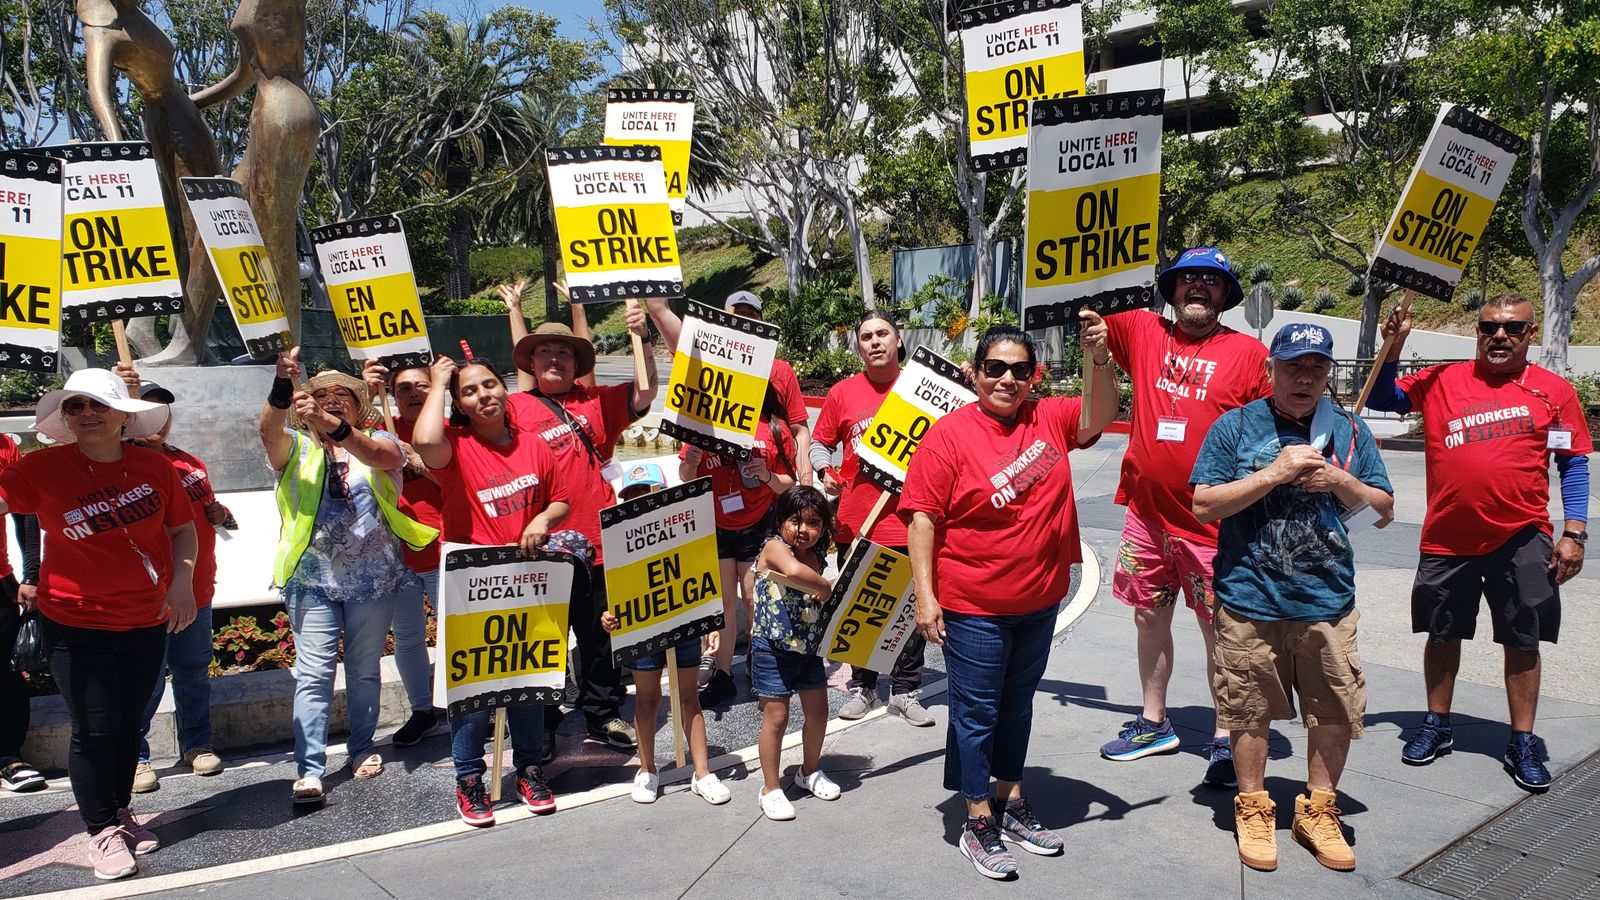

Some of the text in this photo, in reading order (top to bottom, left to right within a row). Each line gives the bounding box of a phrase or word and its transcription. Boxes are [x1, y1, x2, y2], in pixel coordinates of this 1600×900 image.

[985, 21, 1058, 45] UNITE HERE!
[986, 33, 1060, 58] LOCAL 11
[1005, 64, 1046, 99] ON
[621, 120, 676, 132] LOCAL 11
[622, 111, 677, 122] UNITE HERE!
[1059, 130, 1138, 155] UNITE HERE!
[1446, 140, 1497, 171] UNITE HERE!
[1058, 146, 1138, 174] LOCAL 11
[1439, 152, 1492, 185] LOCAL 11
[88, 173, 131, 185] HERE!
[573, 171, 644, 183] UNITE HERE!
[575, 182, 647, 195] LOCAL 11
[116, 185, 134, 198] 11
[12, 206, 31, 223] 11
[209, 209, 237, 221] UNITE
[1075, 187, 1119, 233] ON
[1430, 187, 1468, 226] ON
[70, 215, 124, 250] ON
[214, 221, 250, 236] LOCAL
[597, 208, 639, 236] ON
[569, 236, 674, 268] STRIKE
[1035, 223, 1151, 280] STRIKE
[1392, 210, 1474, 266] STRIKE
[239, 251, 268, 283] ON
[328, 245, 384, 262] UNITE HERE!
[330, 255, 387, 275] LOCAL 11
[346, 285, 376, 314] EN
[338, 309, 420, 348] HUELGA
[696, 329, 755, 355] UNITE HERE!
[694, 338, 753, 366] LOCAL 11
[698, 367, 733, 400] ON
[921, 377, 951, 399] UNITE
[1155, 376, 1207, 401] LOCAL 11
[671, 383, 756, 432] STRIKE
[1463, 405, 1530, 428] WORKERS
[1444, 432, 1464, 449] ON
[1469, 417, 1534, 442] STRIKE
[706, 455, 722, 470] ON
[1002, 439, 1047, 478] WORKERS
[990, 485, 1017, 510] ON
[62, 521, 94, 541] ON
[625, 509, 695, 540] UNITE HERE!
[626, 519, 696, 553] LOCAL 11
[469, 573, 548, 588] UNITE HERE!
[647, 553, 681, 589] EN
[468, 583, 548, 602] LOCAL 11
[613, 571, 718, 630] HUELGA
[831, 552, 898, 655] HUELGA
[865, 592, 898, 628] EN
[891, 590, 917, 631] OCAL
[483, 612, 528, 645] ON
[888, 623, 909, 653] HERE!
[880, 638, 893, 651] 11
[450, 639, 561, 682] STRIKE
